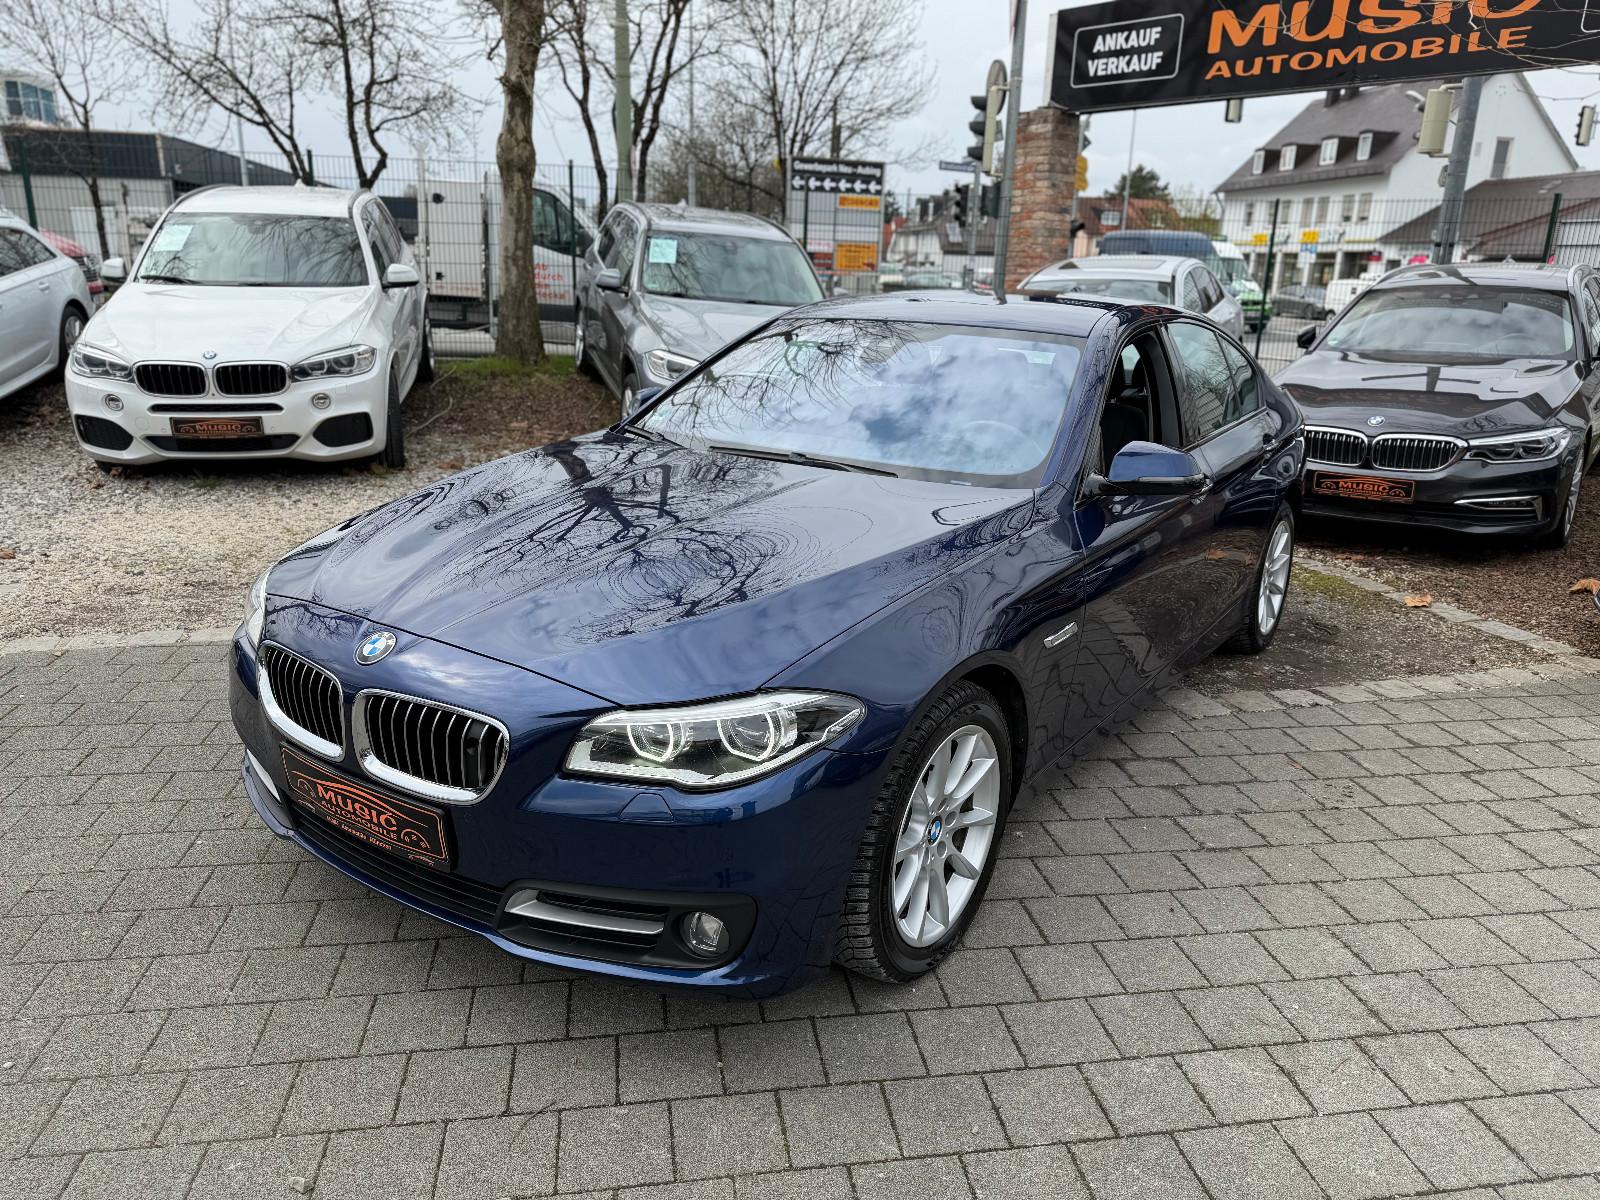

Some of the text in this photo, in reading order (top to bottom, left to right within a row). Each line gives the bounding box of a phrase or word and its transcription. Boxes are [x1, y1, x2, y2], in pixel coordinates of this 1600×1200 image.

[1092, 26, 1162, 53] ANKAUF
[1204, 26, 1532, 80] AUTOMOBILE
[1087, 51, 1163, 77] VERKAUF
[1339, 481, 1390, 492] MUSIC
[316, 783, 398, 832] MUSIC
[321, 800, 398, 841] AUTOMOBILE
